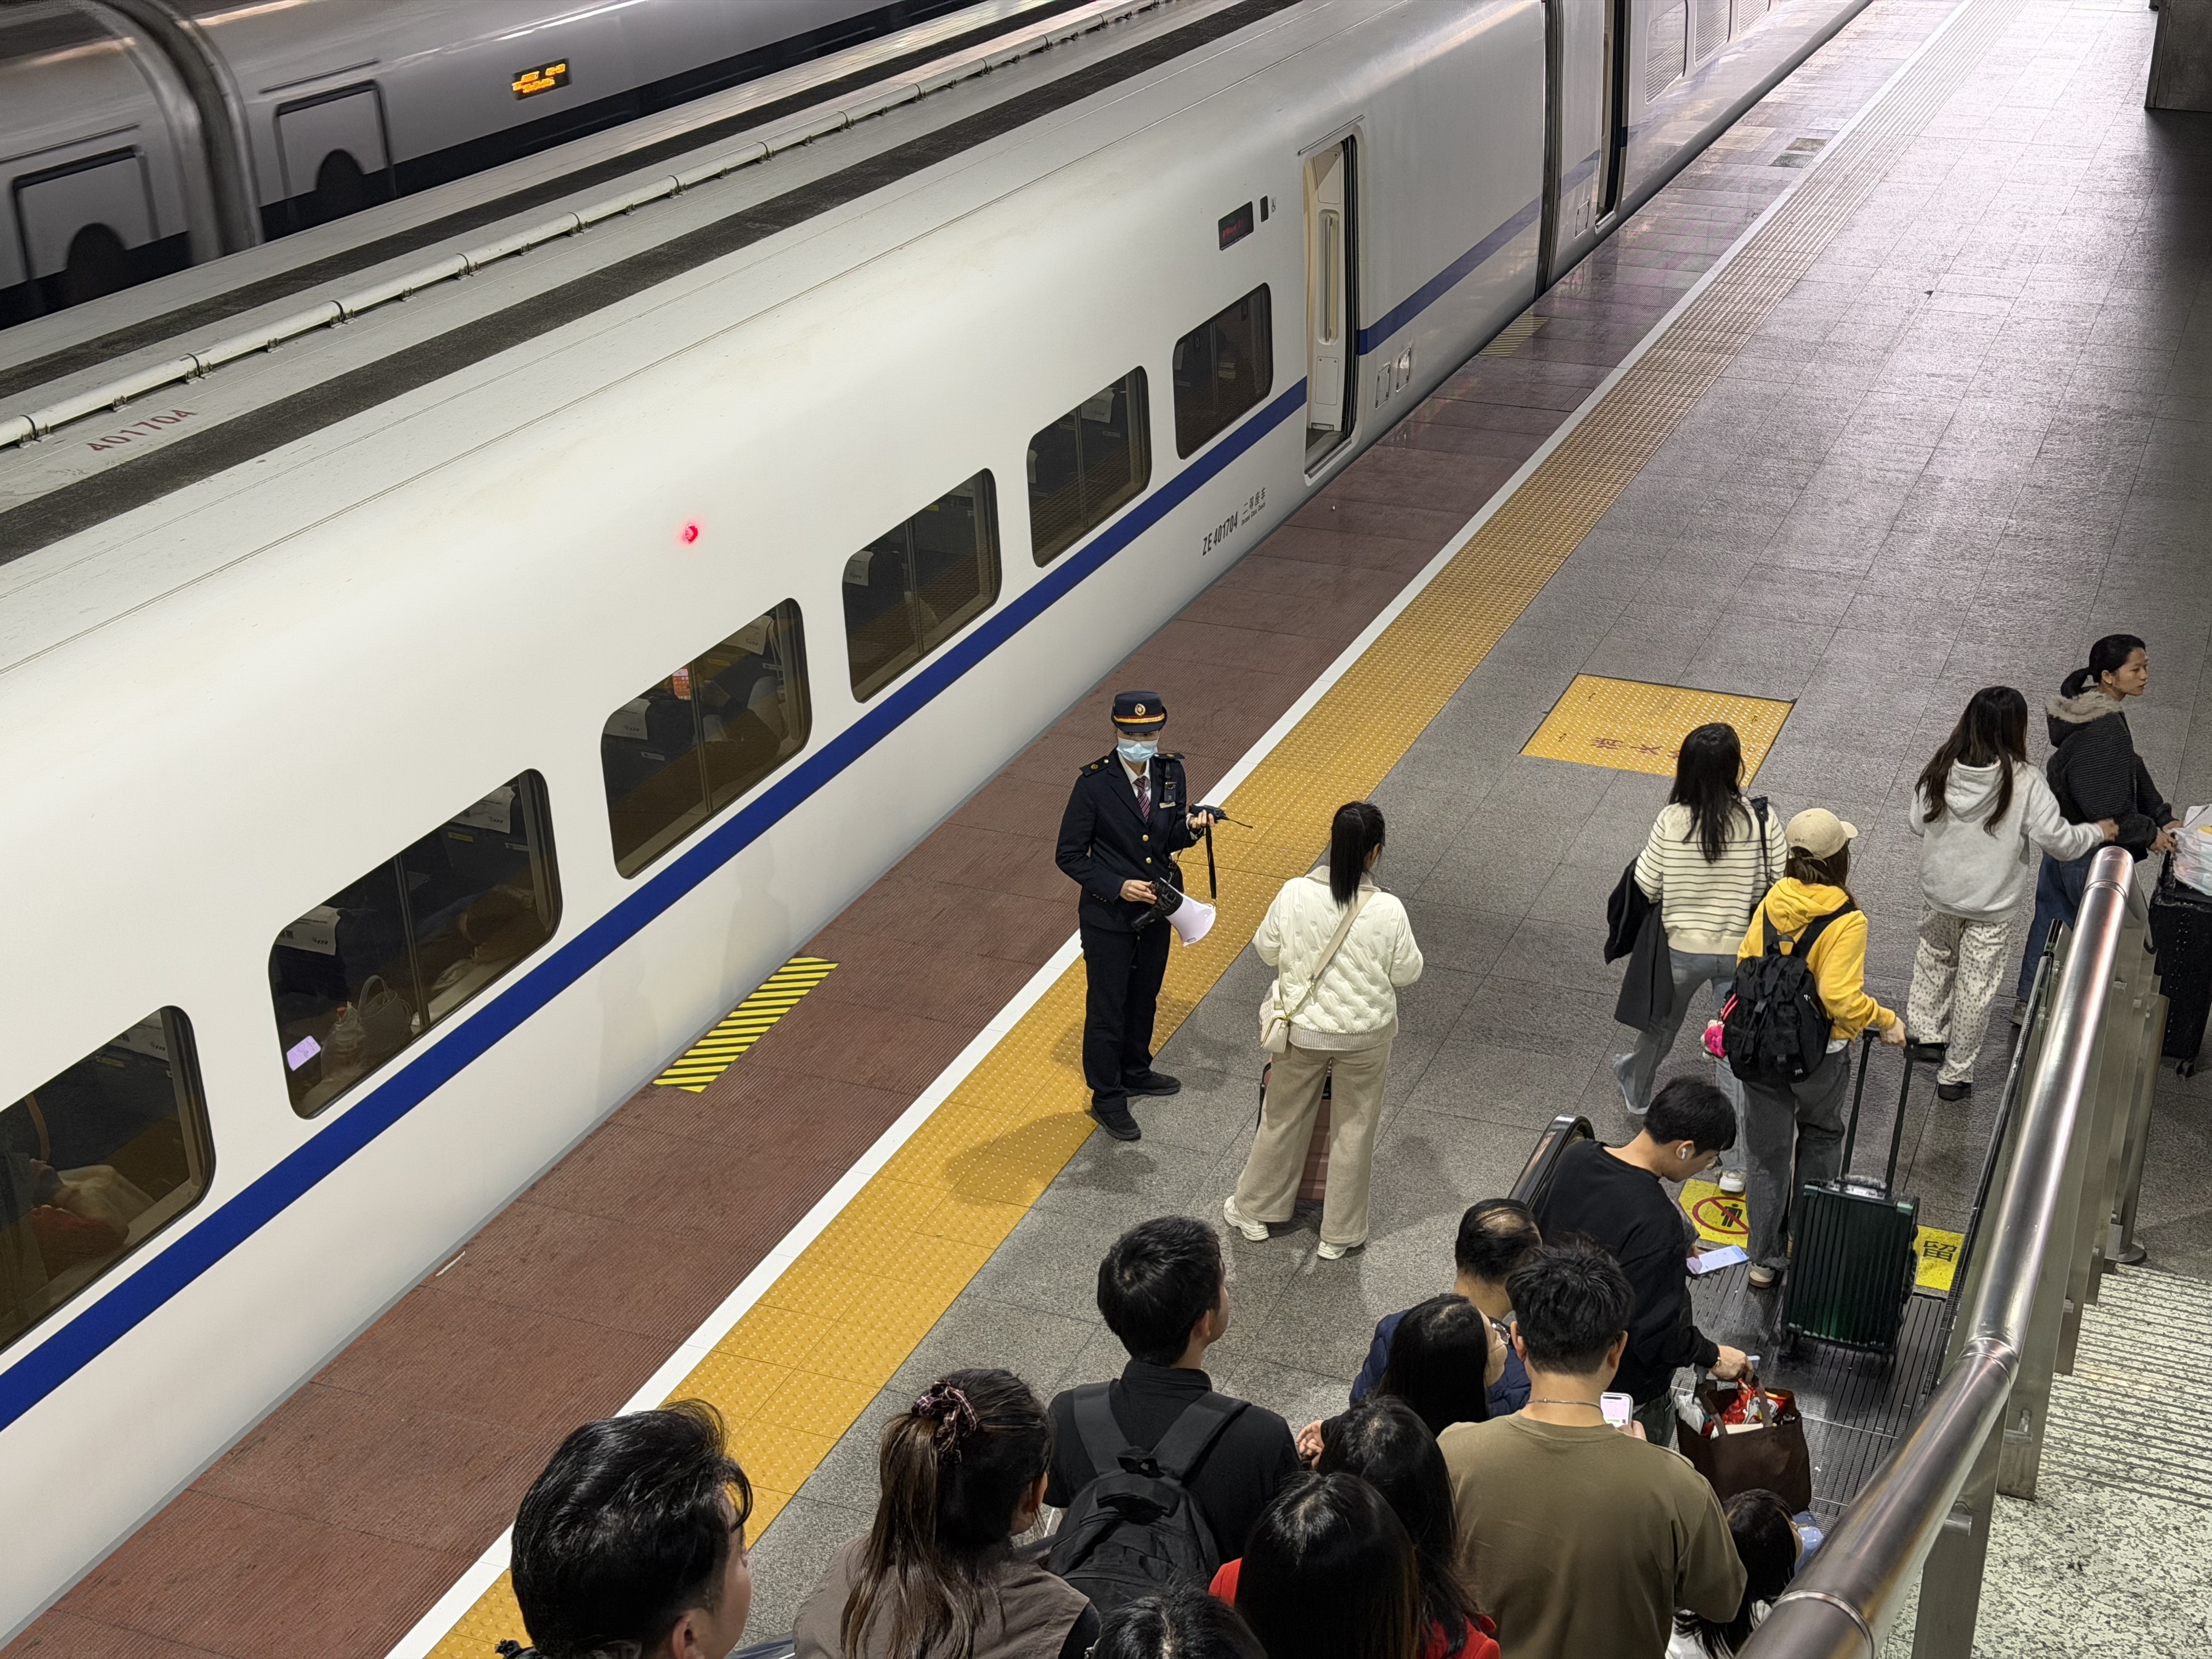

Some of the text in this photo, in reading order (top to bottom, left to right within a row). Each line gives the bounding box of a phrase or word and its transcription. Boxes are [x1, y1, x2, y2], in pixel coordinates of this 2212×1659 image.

[87, 409, 197, 451] 401704
[1203, 511, 1238, 556] ZE 401704
[1923, 1240, 1957, 1262] 留
